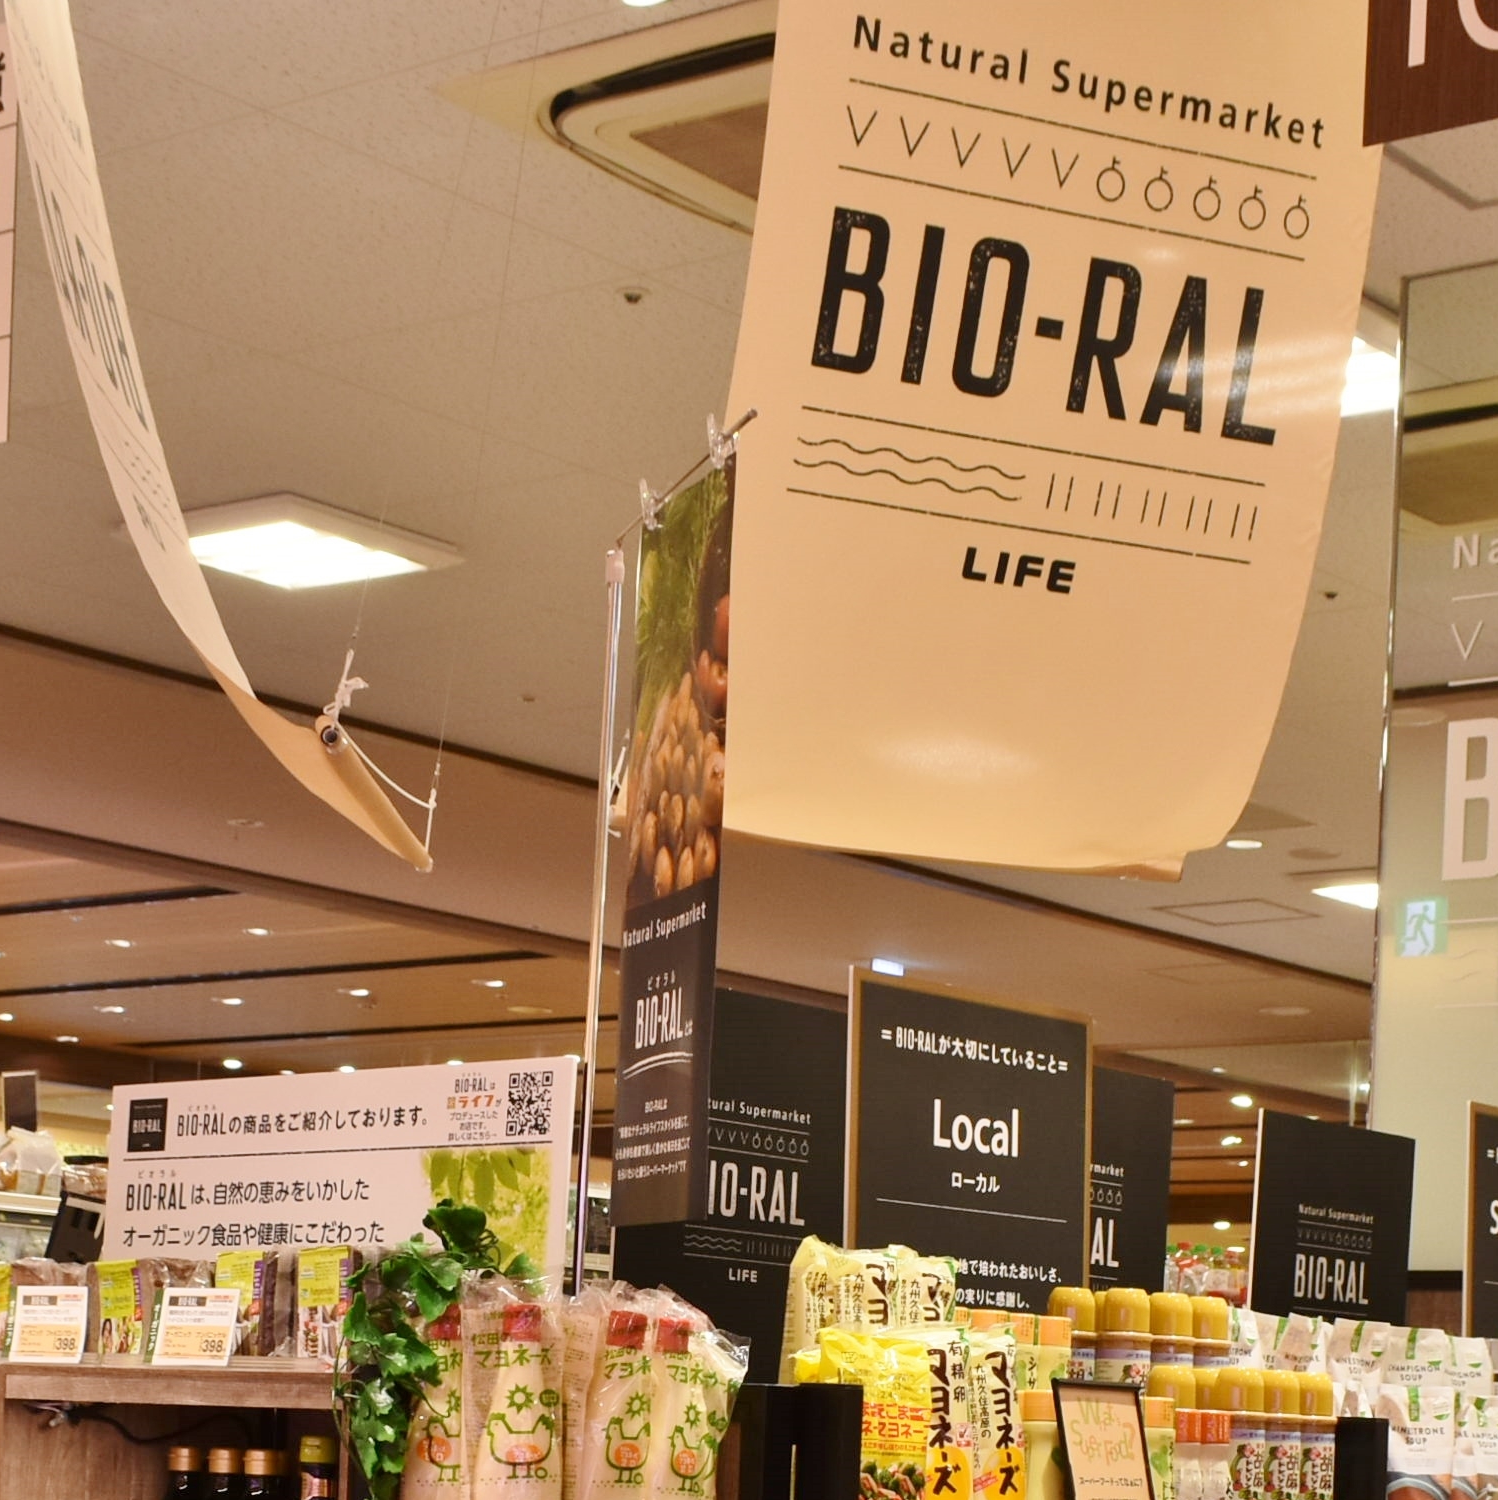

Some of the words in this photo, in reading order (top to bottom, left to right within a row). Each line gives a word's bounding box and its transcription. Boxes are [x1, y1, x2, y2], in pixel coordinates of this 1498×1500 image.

[854, 13, 1030, 87] Natural
[1052, 58, 1327, 150] Supermarket
[809, 206, 1278, 446] BIO-RAL
[961, 545, 1077, 595] LIFE
[655, 901, 707, 940] Supermarket
[739, 1101, 812, 1126] Supermarket
[932, 1097, 1019, 1158] Local
[708, 1159, 806, 1227] IO-RAL
[950, 1171, 1001, 1194] ローカル
[122, 1221, 385, 1248] オーガニック食品や健康にこだわった
[1298, 1202, 1327, 1218] Natural
[1327, 1206, 1374, 1225] Supermarket
[728, 1267, 759, 1285] LIFE
[1293, 1253, 1369, 1306] BIO-RAL
[927, 1348, 961, 1496] マヨネーズ
[984, 1349, 1020, 1496] マヨネーズ
